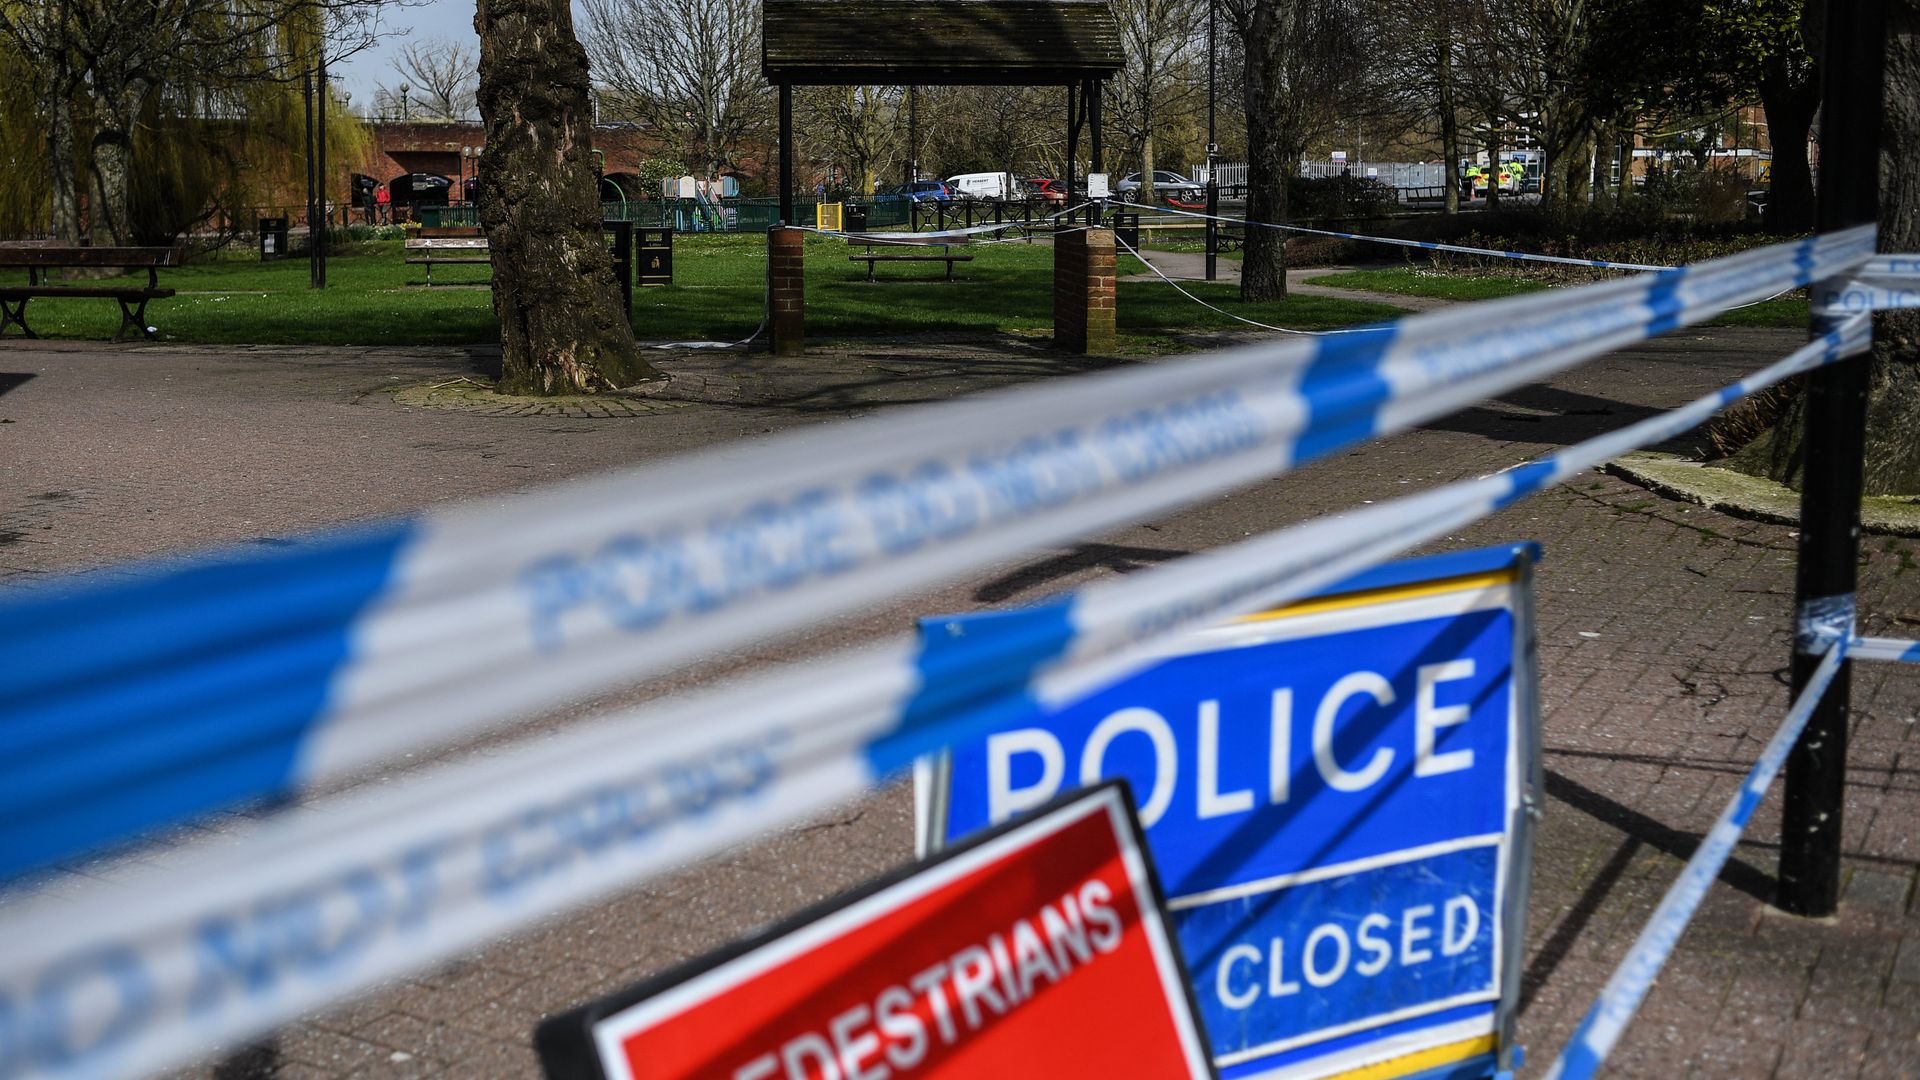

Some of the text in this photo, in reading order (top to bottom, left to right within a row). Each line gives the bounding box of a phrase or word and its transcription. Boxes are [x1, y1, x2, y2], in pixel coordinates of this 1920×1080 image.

[1823, 289, 1920, 309] POLIC
[987, 658, 1476, 831] POLICE
[733, 878, 1123, 1080] DESTRIANS
[1215, 894, 1481, 1011] CLOSED
